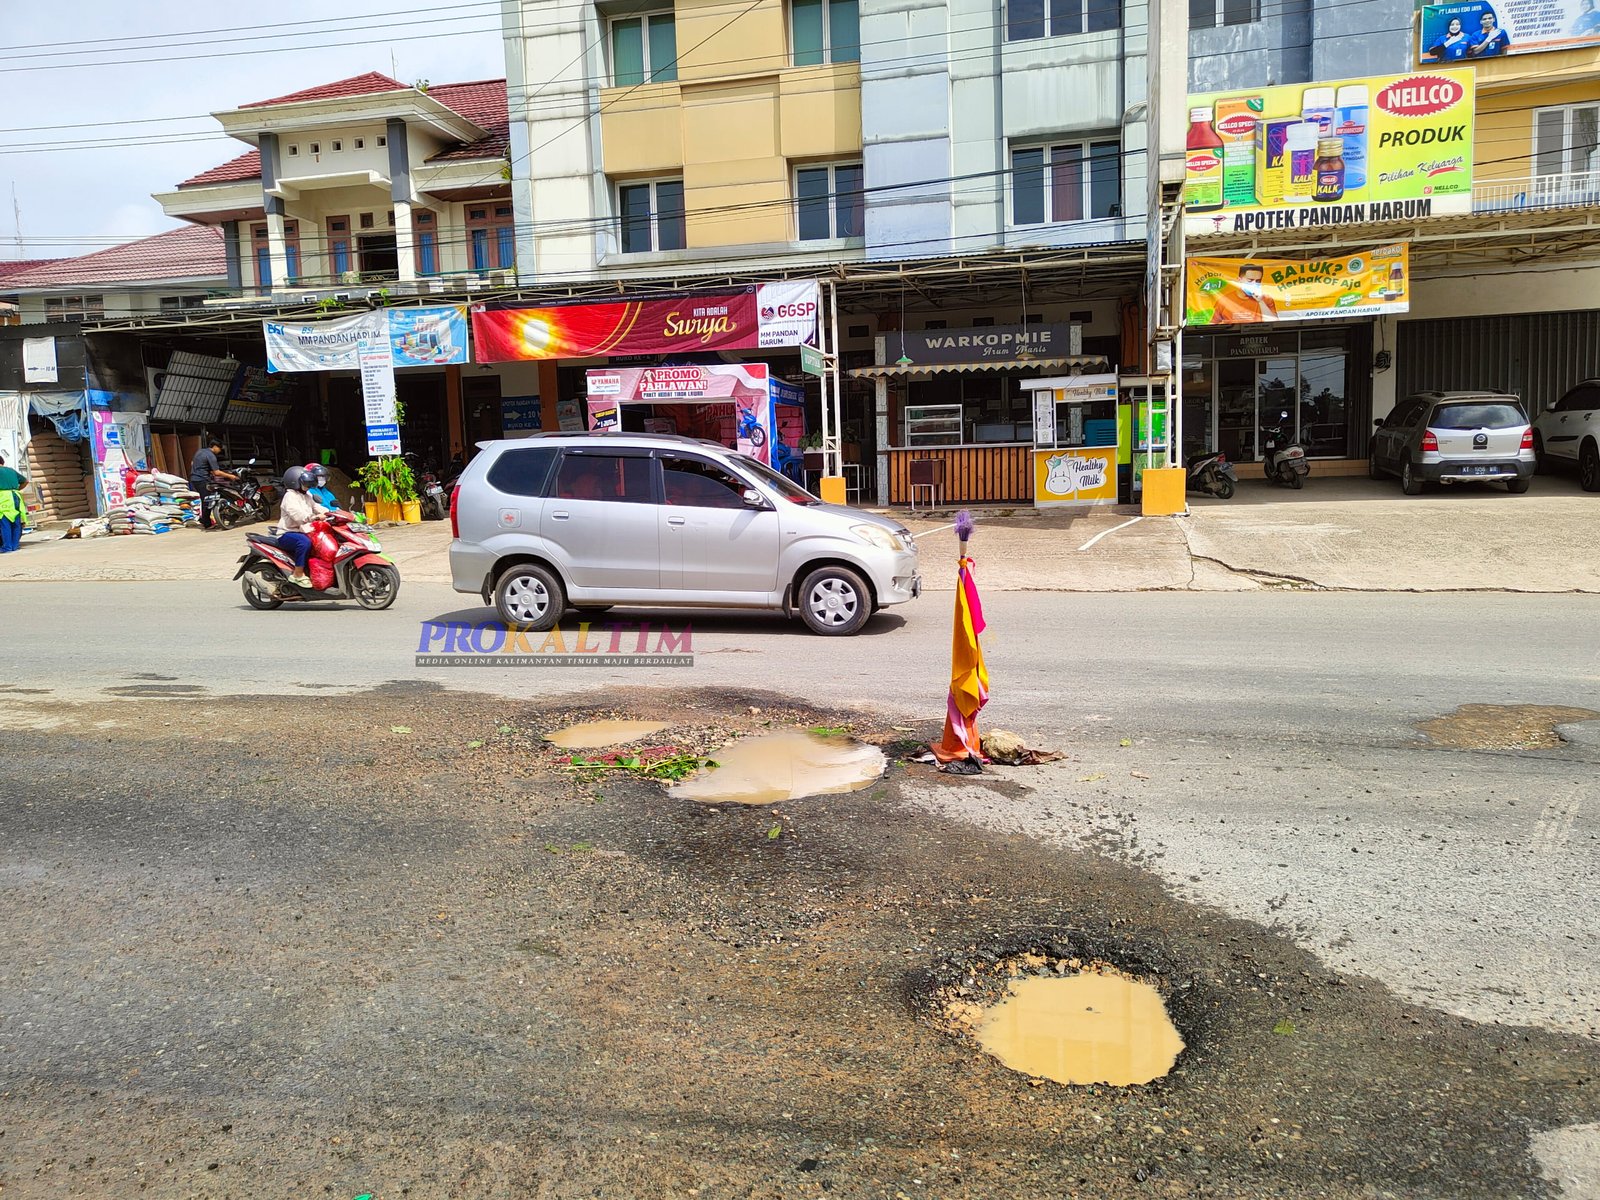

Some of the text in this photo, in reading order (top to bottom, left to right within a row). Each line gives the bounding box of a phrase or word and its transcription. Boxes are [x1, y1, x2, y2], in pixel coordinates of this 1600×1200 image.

[1387, 84, 1454, 109] NELLCO
[1379, 125, 1466, 148] PRODUK
[1417, 156, 1464, 174] Keluarga
[1379, 168, 1414, 184] Pilihan
[1318, 184, 1339, 194] KALK
[1234, 198, 1432, 232] APOTEK PANDAN HARUM
[1340, 279, 1362, 291] Aja
[778, 302, 816, 318] GGSP
[664, 312, 737, 344] Surya
[772, 330, 798, 338] PANDAN
[314, 332, 349, 344] PANDAN
[760, 338, 784, 346] HARUM
[925, 332, 1052, 348] WARKOPMIE
[1240, 336, 1268, 345] APOTEK
[656, 369, 700, 380] PROMO
[640, 380, 708, 391] PAHLAWAN!
[1072, 457, 1106, 473] Healthy
[1080, 475, 1101, 488] Milk
